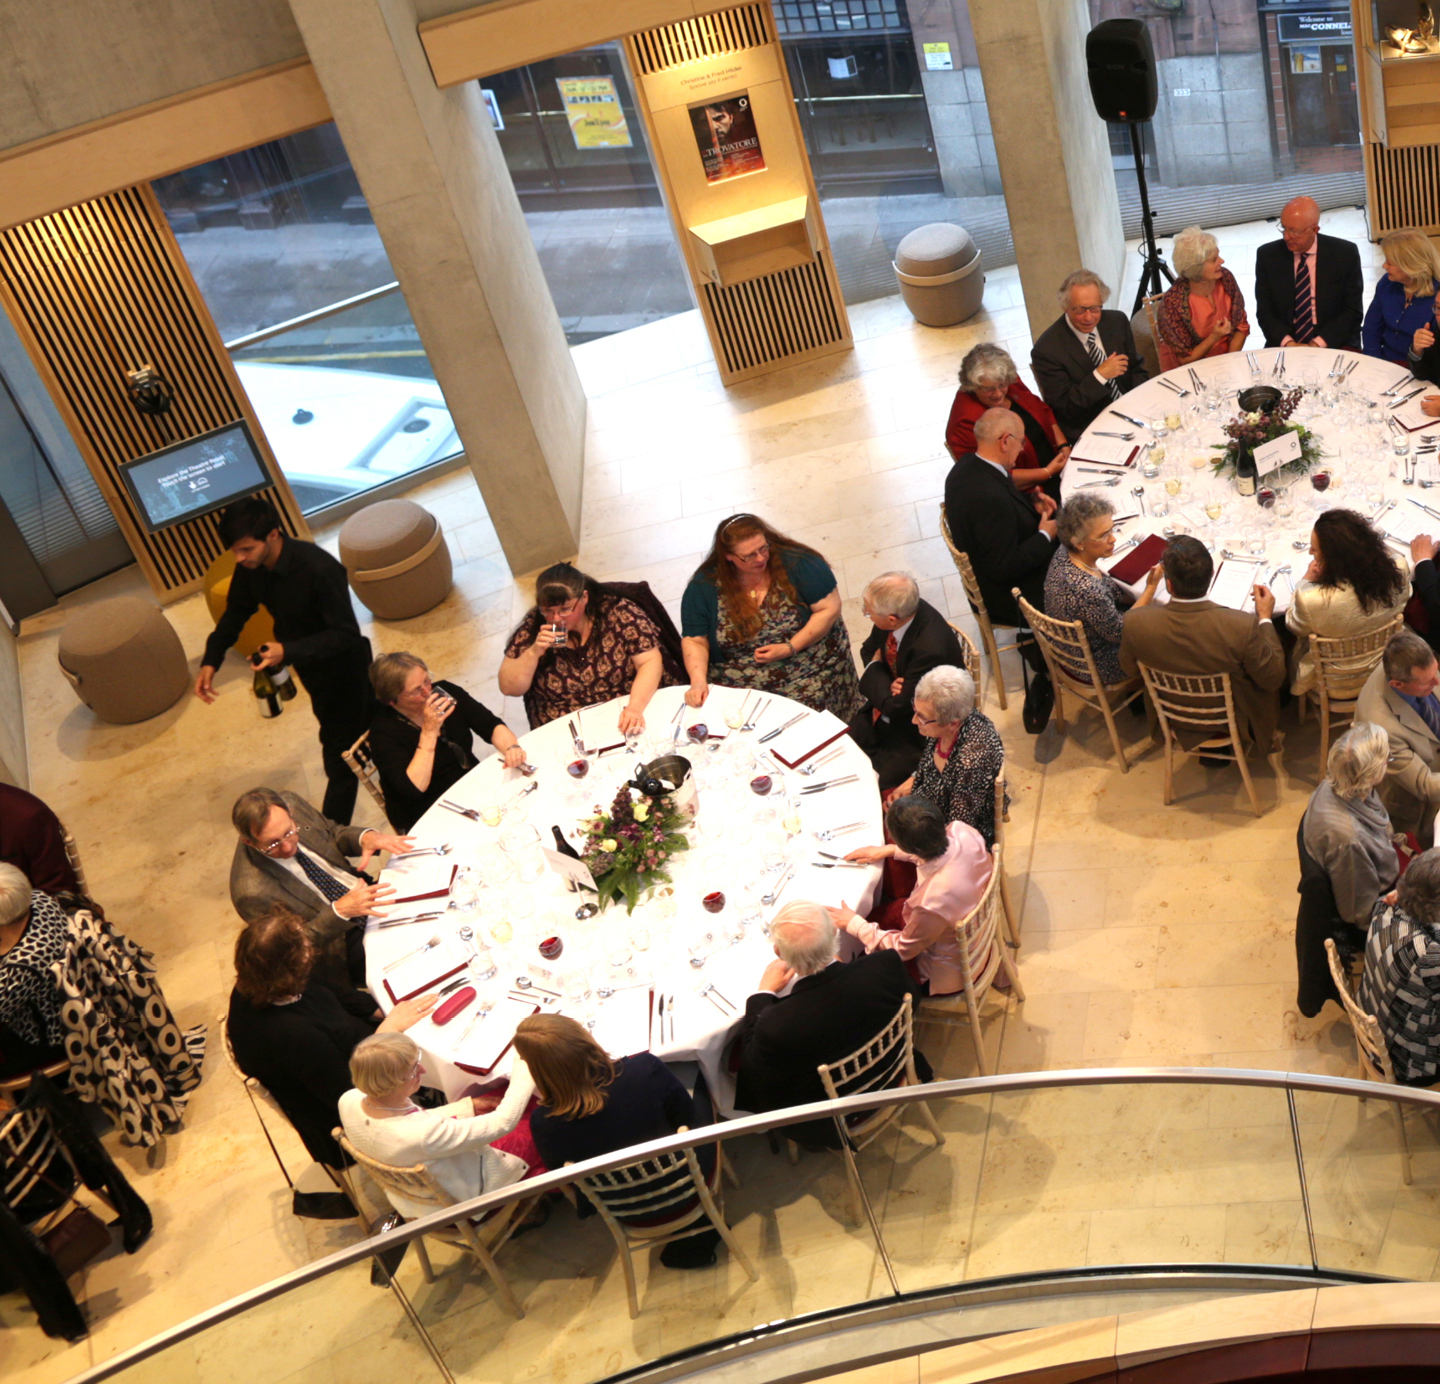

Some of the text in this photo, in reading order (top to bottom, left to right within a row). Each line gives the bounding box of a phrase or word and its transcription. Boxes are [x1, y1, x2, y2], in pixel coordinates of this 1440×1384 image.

[680, 74, 705, 86] Christine
[706, 137, 757, 156] TROVATORE
[158, 473, 179, 483] Explore
[188, 461, 209, 472] Theatre
[162, 478, 178, 487] Touch
[188, 469, 206, 478] screen
[213, 461, 225, 469] start
